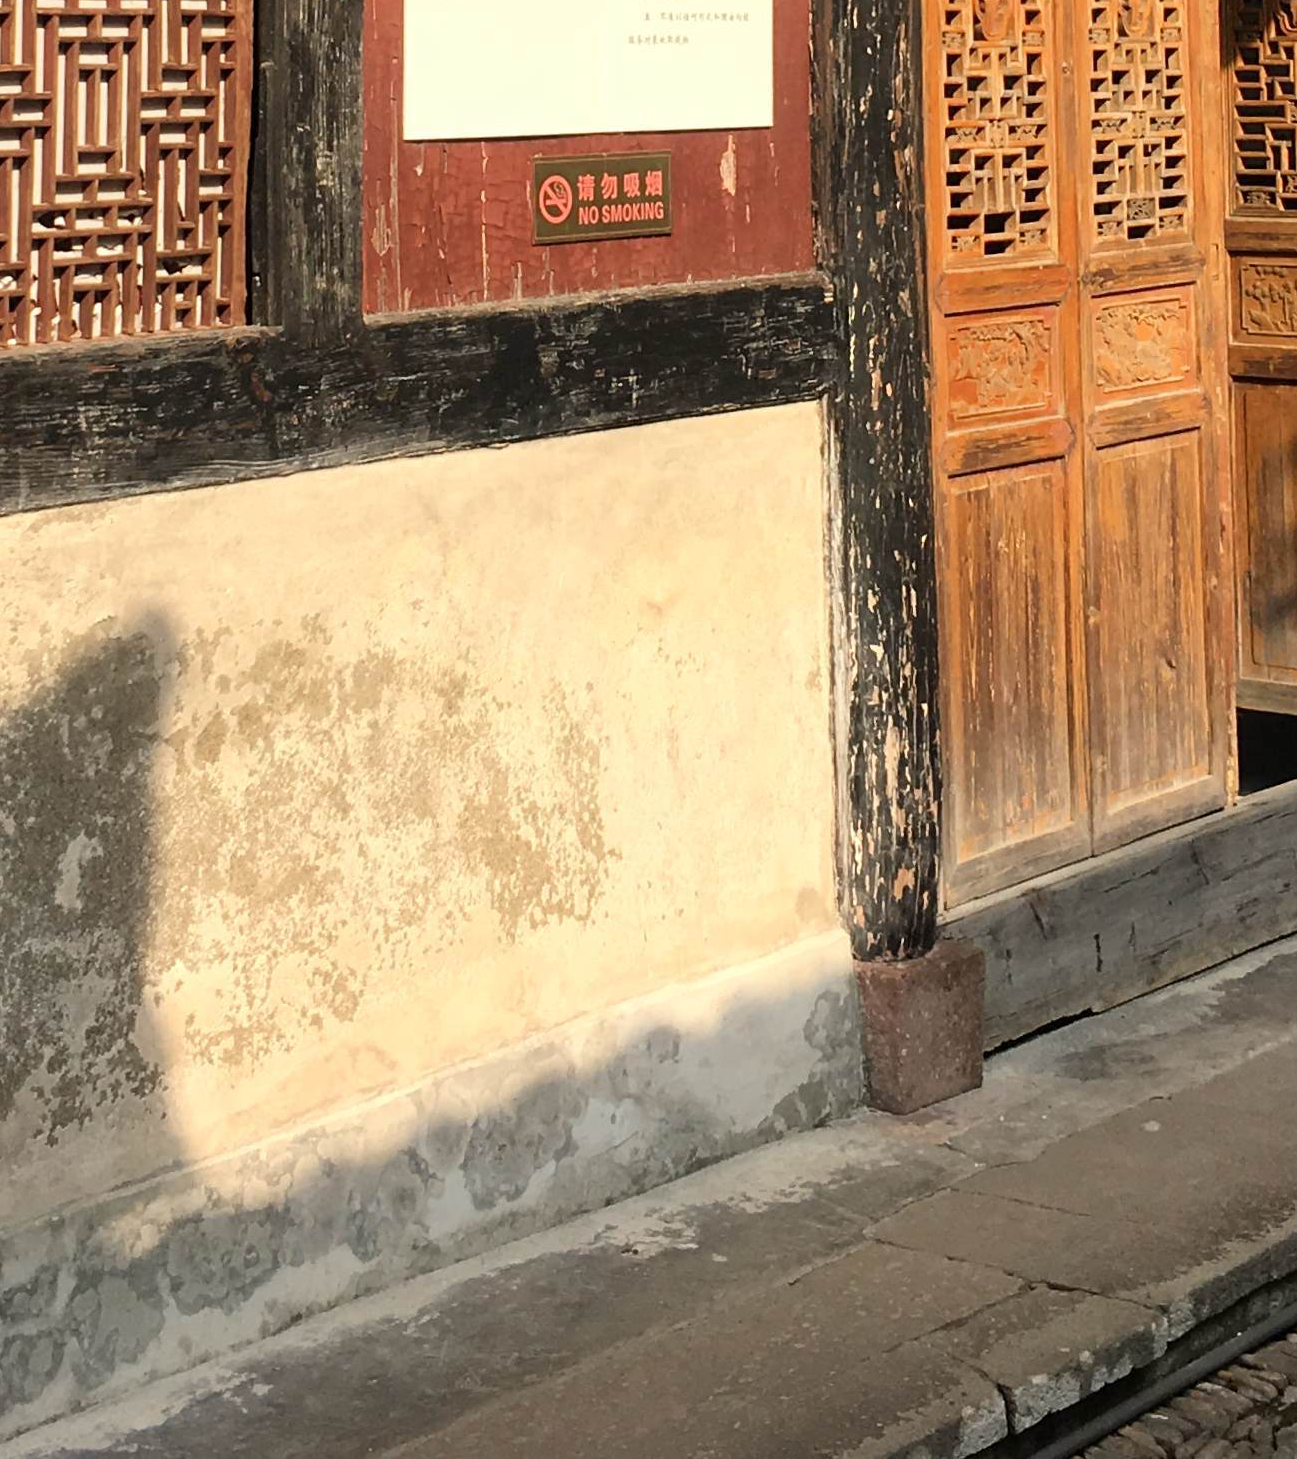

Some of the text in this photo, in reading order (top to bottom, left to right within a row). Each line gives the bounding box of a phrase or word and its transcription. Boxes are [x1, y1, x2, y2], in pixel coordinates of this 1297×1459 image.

[577, 170, 664, 201] 请勿吸烟
[578, 201, 664, 225] NO SMOKING
